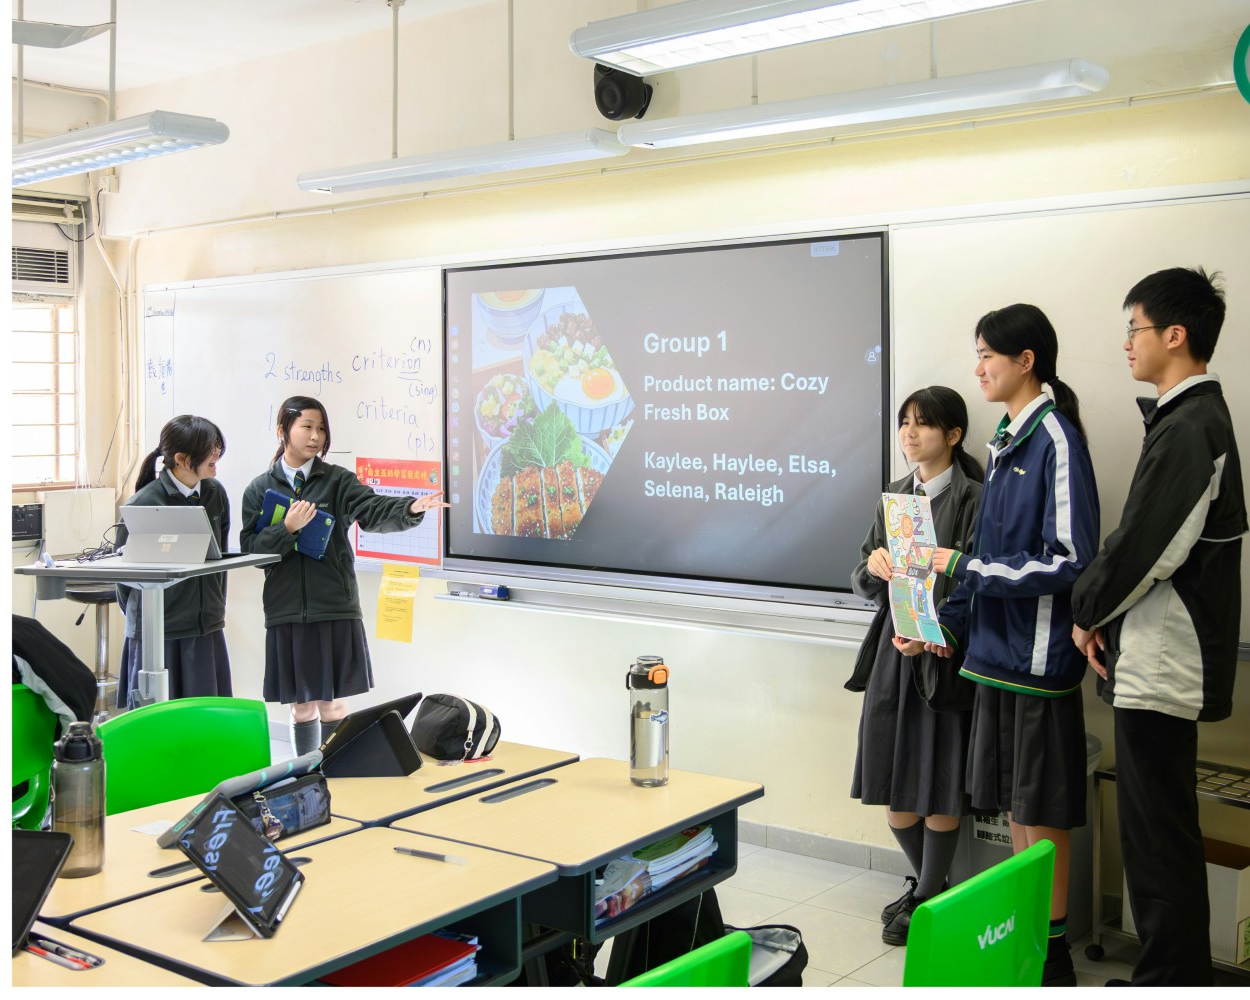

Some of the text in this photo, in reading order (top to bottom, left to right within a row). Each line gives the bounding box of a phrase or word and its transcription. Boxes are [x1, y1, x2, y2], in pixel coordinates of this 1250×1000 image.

[410, 336, 432, 354] (n)
[644, 330, 727, 358] Group 1
[352, 348, 421, 372] criterion
[264, 352, 343, 396] 2 strengths
[644, 372, 829, 395] Product name: Cozy
[356, 397, 419, 427] criteria
[644, 403, 730, 421] Fresh Box
[644, 452, 837, 477] Kaylee, Haylee, Elsa,
[644, 481, 784, 507] Selena, Raleigh
